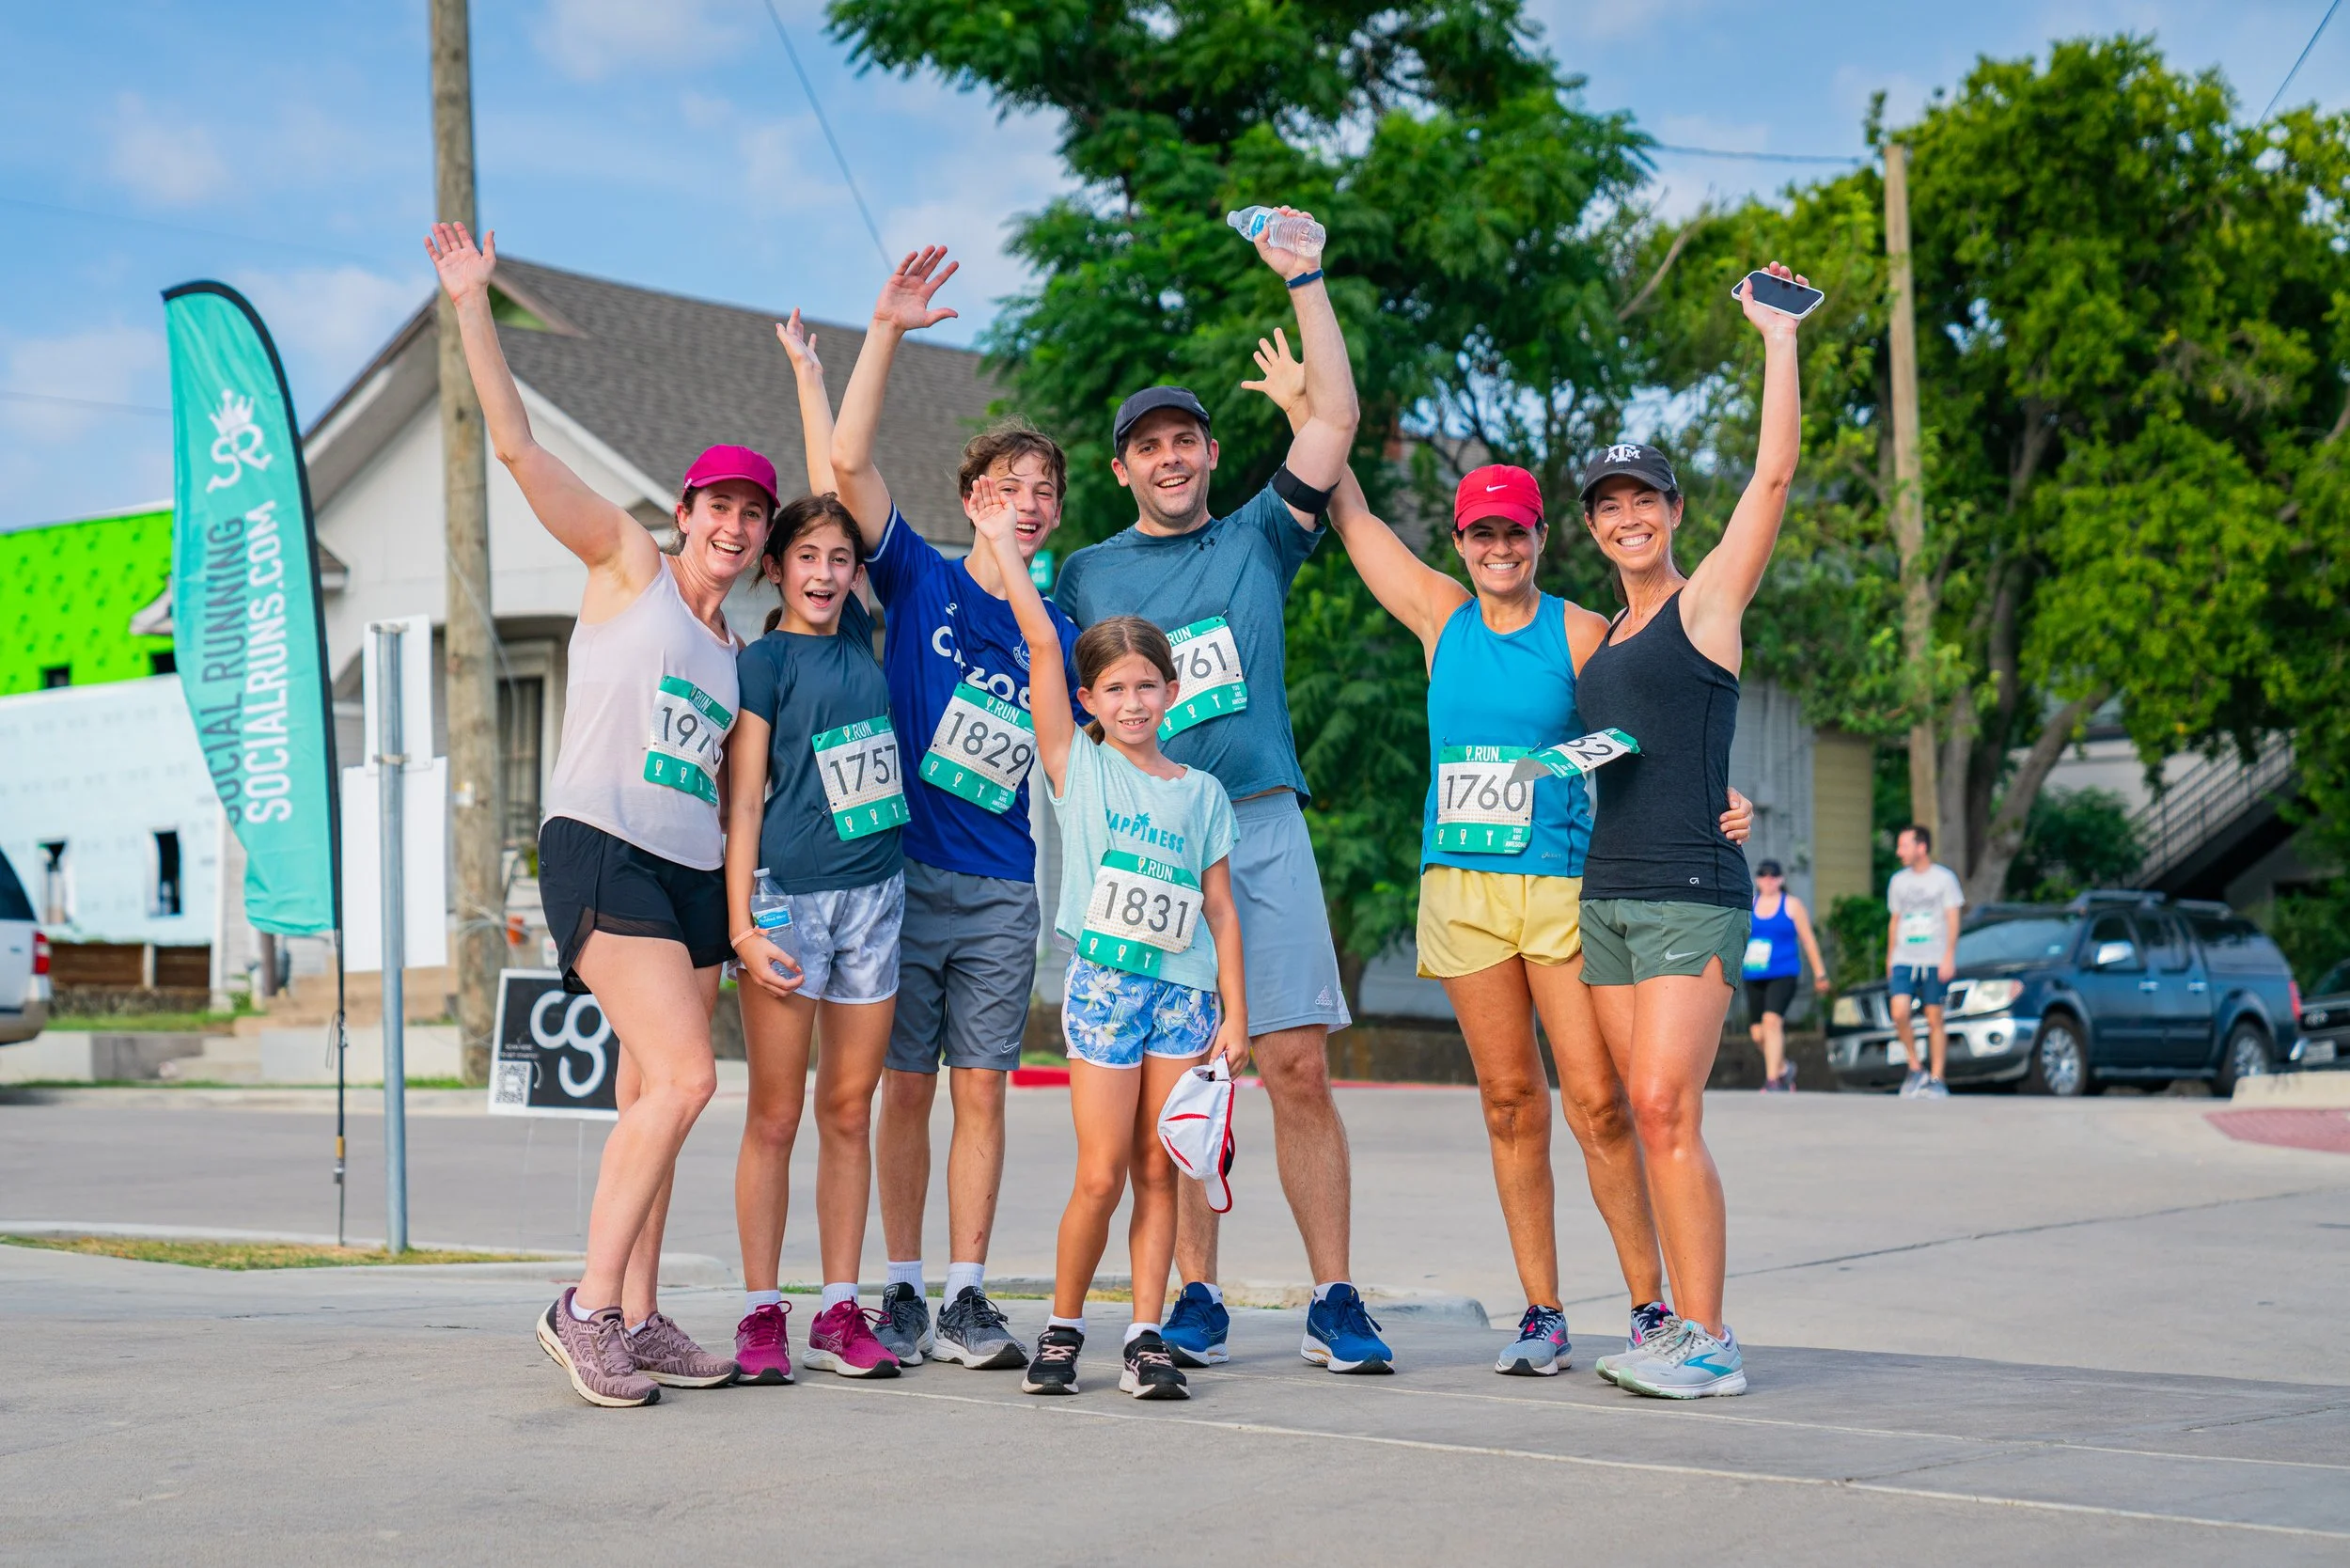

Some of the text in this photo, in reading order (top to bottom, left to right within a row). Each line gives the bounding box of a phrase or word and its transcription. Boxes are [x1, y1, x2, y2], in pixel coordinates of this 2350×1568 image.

[201, 515, 247, 684] RUNNING
[243, 499, 293, 823] SOCIALRUNS.COM
[829, 744, 897, 795] 1757
[947, 711, 1031, 776] 1829
[1447, 774, 1527, 812] 1760
[1104, 881, 1189, 938] 1831
